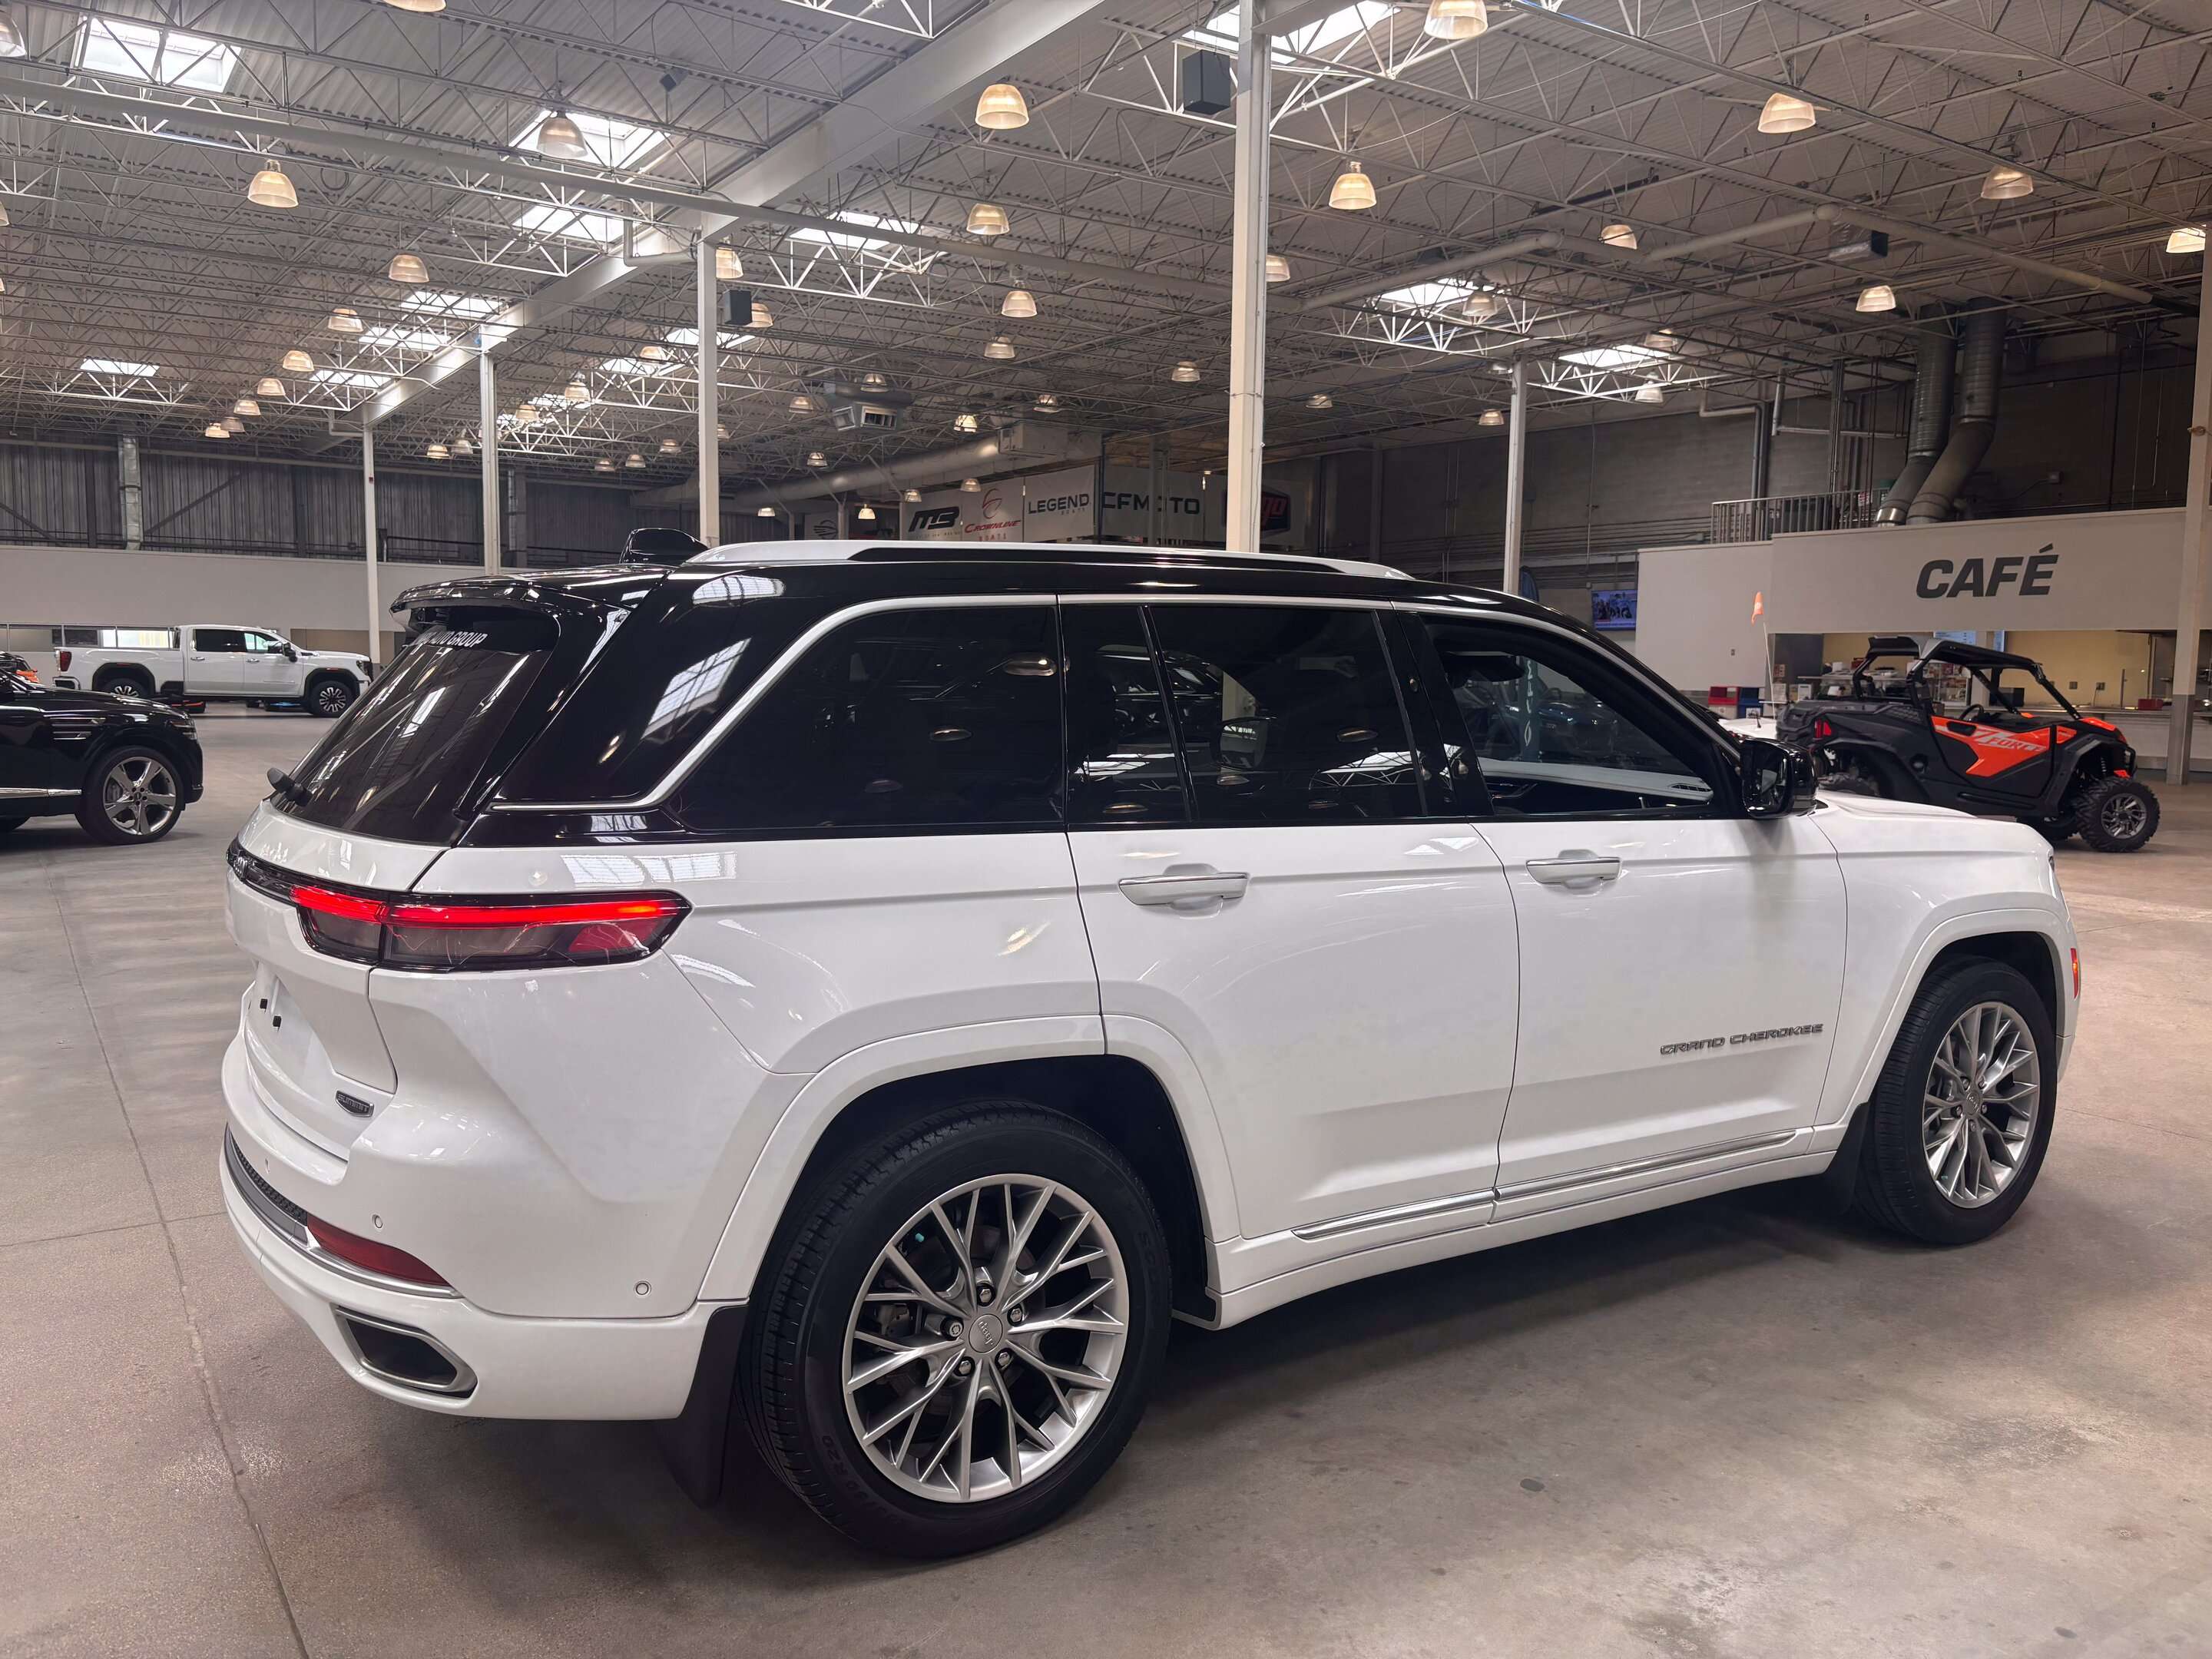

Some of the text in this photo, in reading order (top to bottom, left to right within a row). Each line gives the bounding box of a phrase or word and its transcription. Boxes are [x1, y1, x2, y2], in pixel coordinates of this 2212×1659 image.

[1028, 494, 1089, 514] LEGEND
[1916, 543, 2059, 598] CAFÉ
[446, 631, 488, 647] GROUP
[1660, 1024, 1823, 1055] GRAND CHEROKEE
